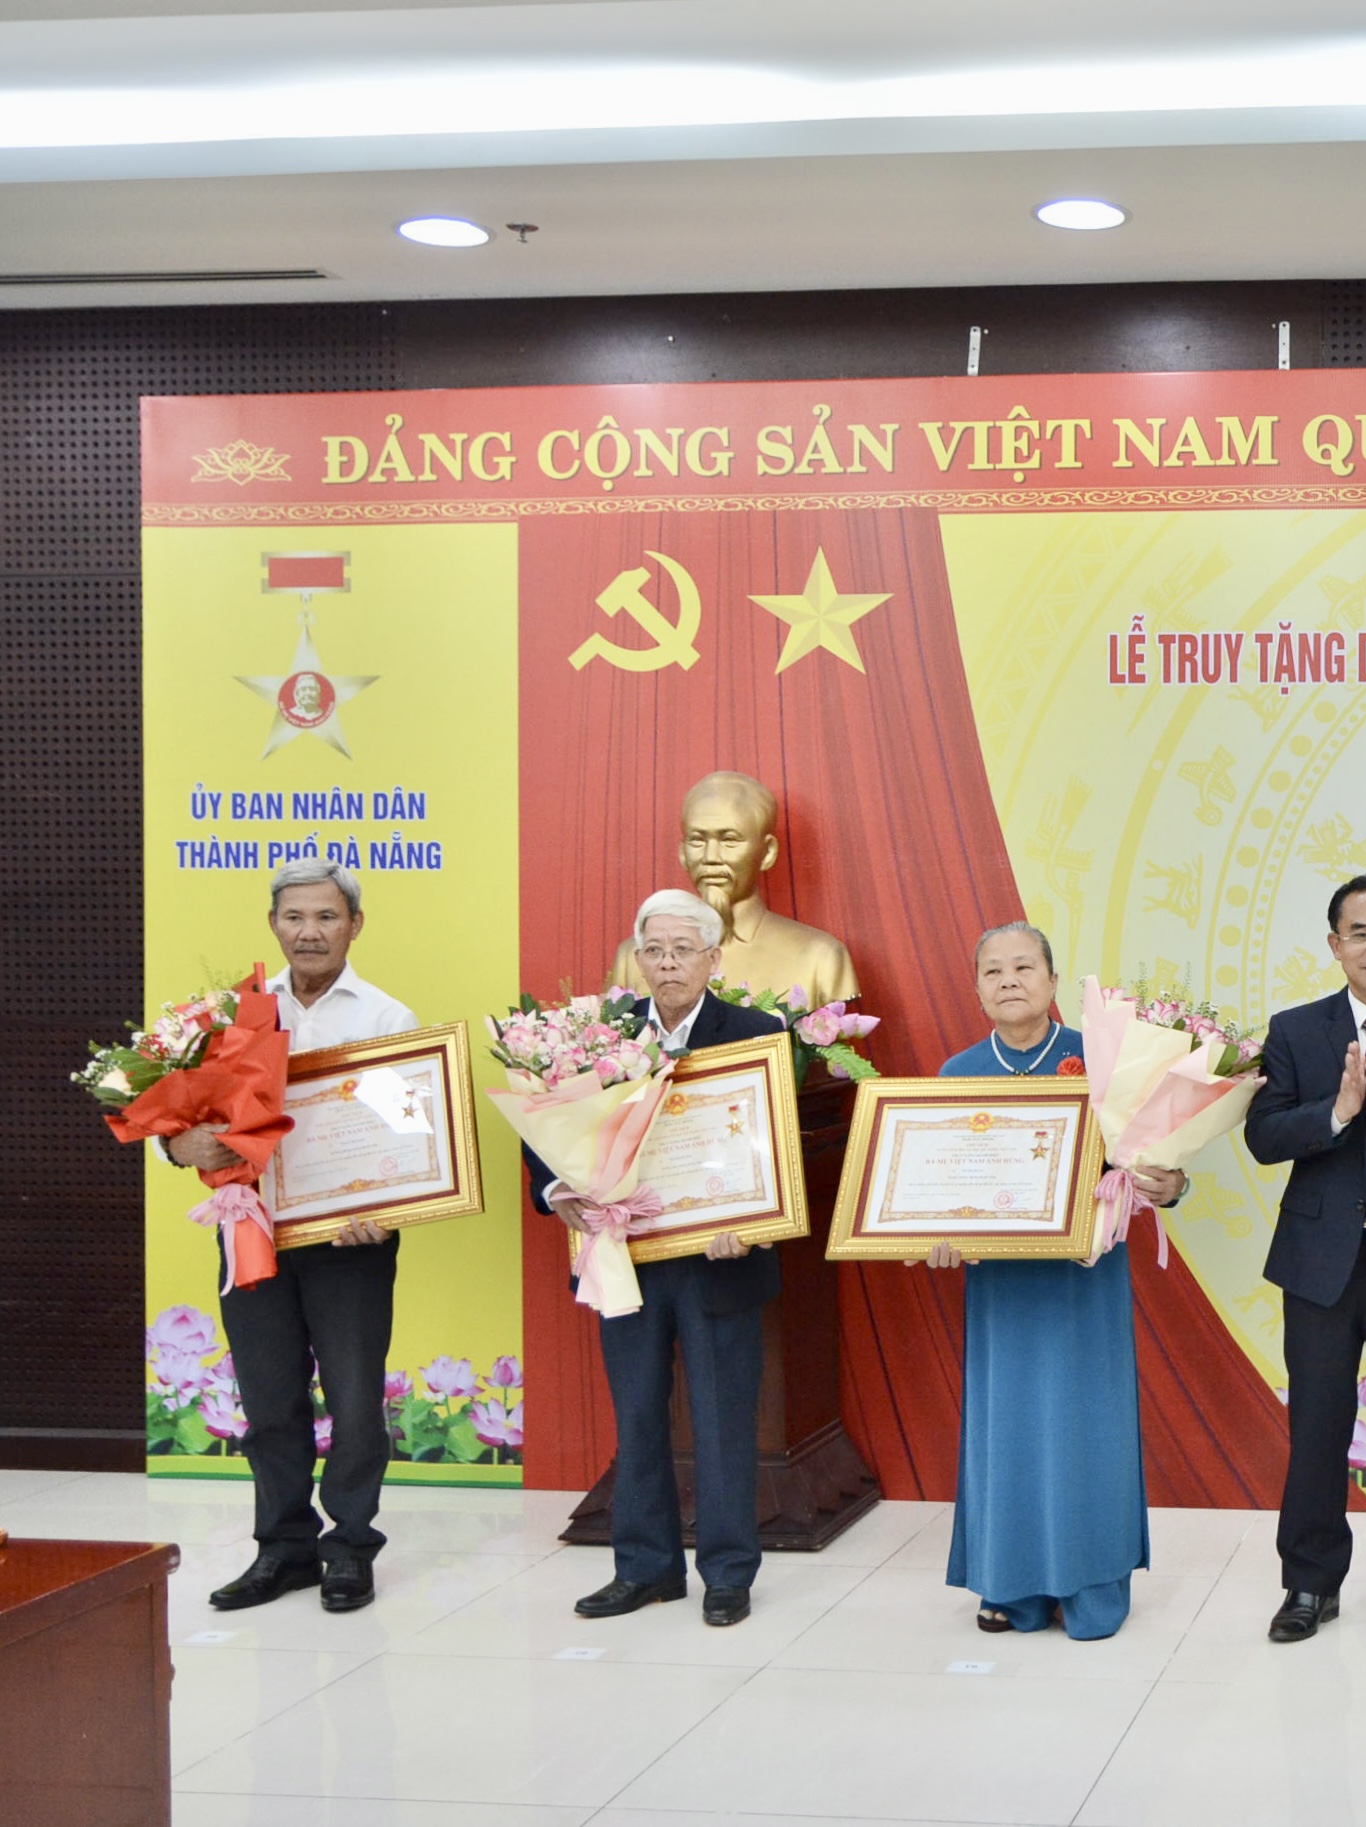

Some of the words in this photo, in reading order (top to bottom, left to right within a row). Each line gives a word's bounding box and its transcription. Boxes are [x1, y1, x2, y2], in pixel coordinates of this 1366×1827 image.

[321, 413, 517, 484] ĐẢNG
[537, 415, 734, 491] CỘNG
[757, 404, 898, 475] SẢN
[918, 405, 1092, 483] VIỆT
[1112, 416, 1279, 467] NAM
[1109, 615, 1146, 684] LỄ
[1158, 634, 1243, 683] TRUY
[1256, 622, 1345, 694] TẶNG
[191, 783, 222, 820] ỦY
[232, 793, 283, 820] BAN
[292, 787, 364, 820] NHÂN
[373, 786, 426, 820] DÂN
[176, 836, 259, 869] THÀNH
[268, 832, 318, 868] PHỐ
[327, 835, 361, 869] ĐÀ
[370, 832, 442, 870] NẴNG
